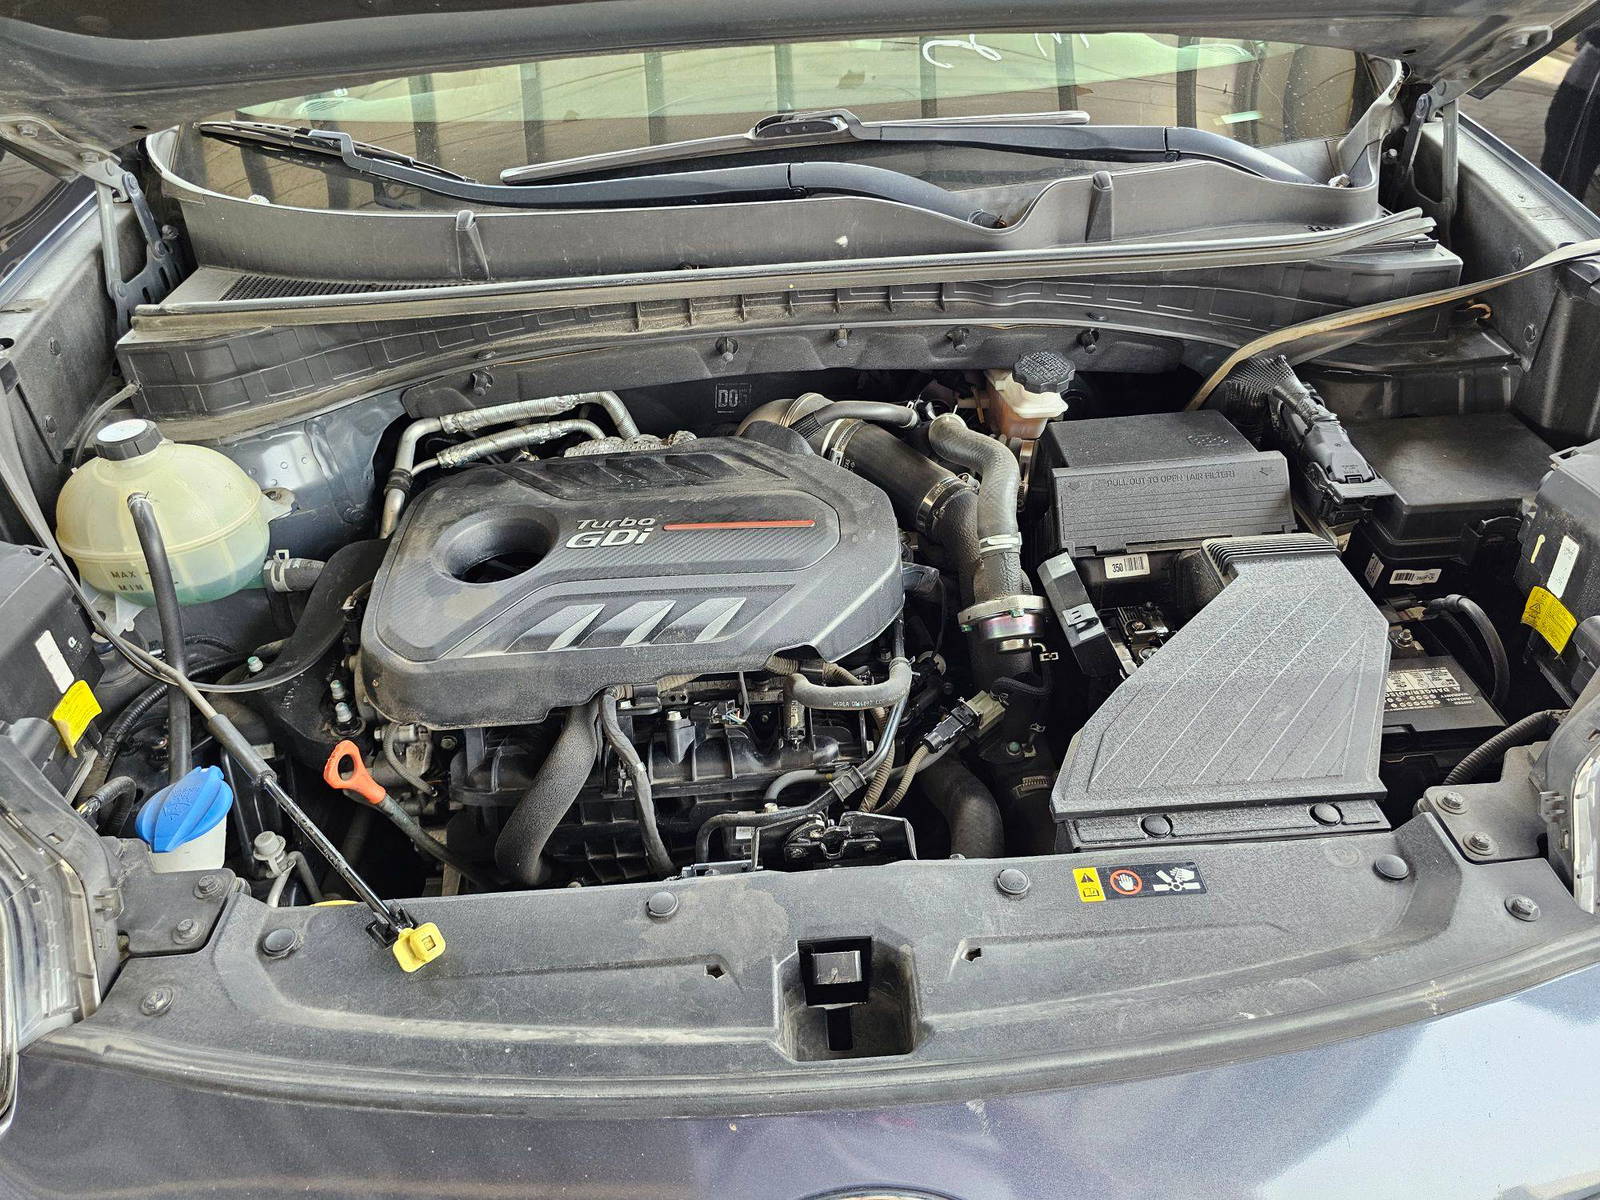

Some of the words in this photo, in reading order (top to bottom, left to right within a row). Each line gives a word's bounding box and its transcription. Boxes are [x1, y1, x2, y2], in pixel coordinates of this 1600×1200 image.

[1107, 479, 1127, 487] PULL
[1130, 478, 1146, 486] OUT
[1149, 476, 1159, 484] TO
[1162, 474, 1183, 483] OPEN
[577, 517, 656, 530] Turbo
[565, 528, 654, 549] GDi
[1112, 563, 1123, 572] 350
[110, 570, 136, 579] MAX
